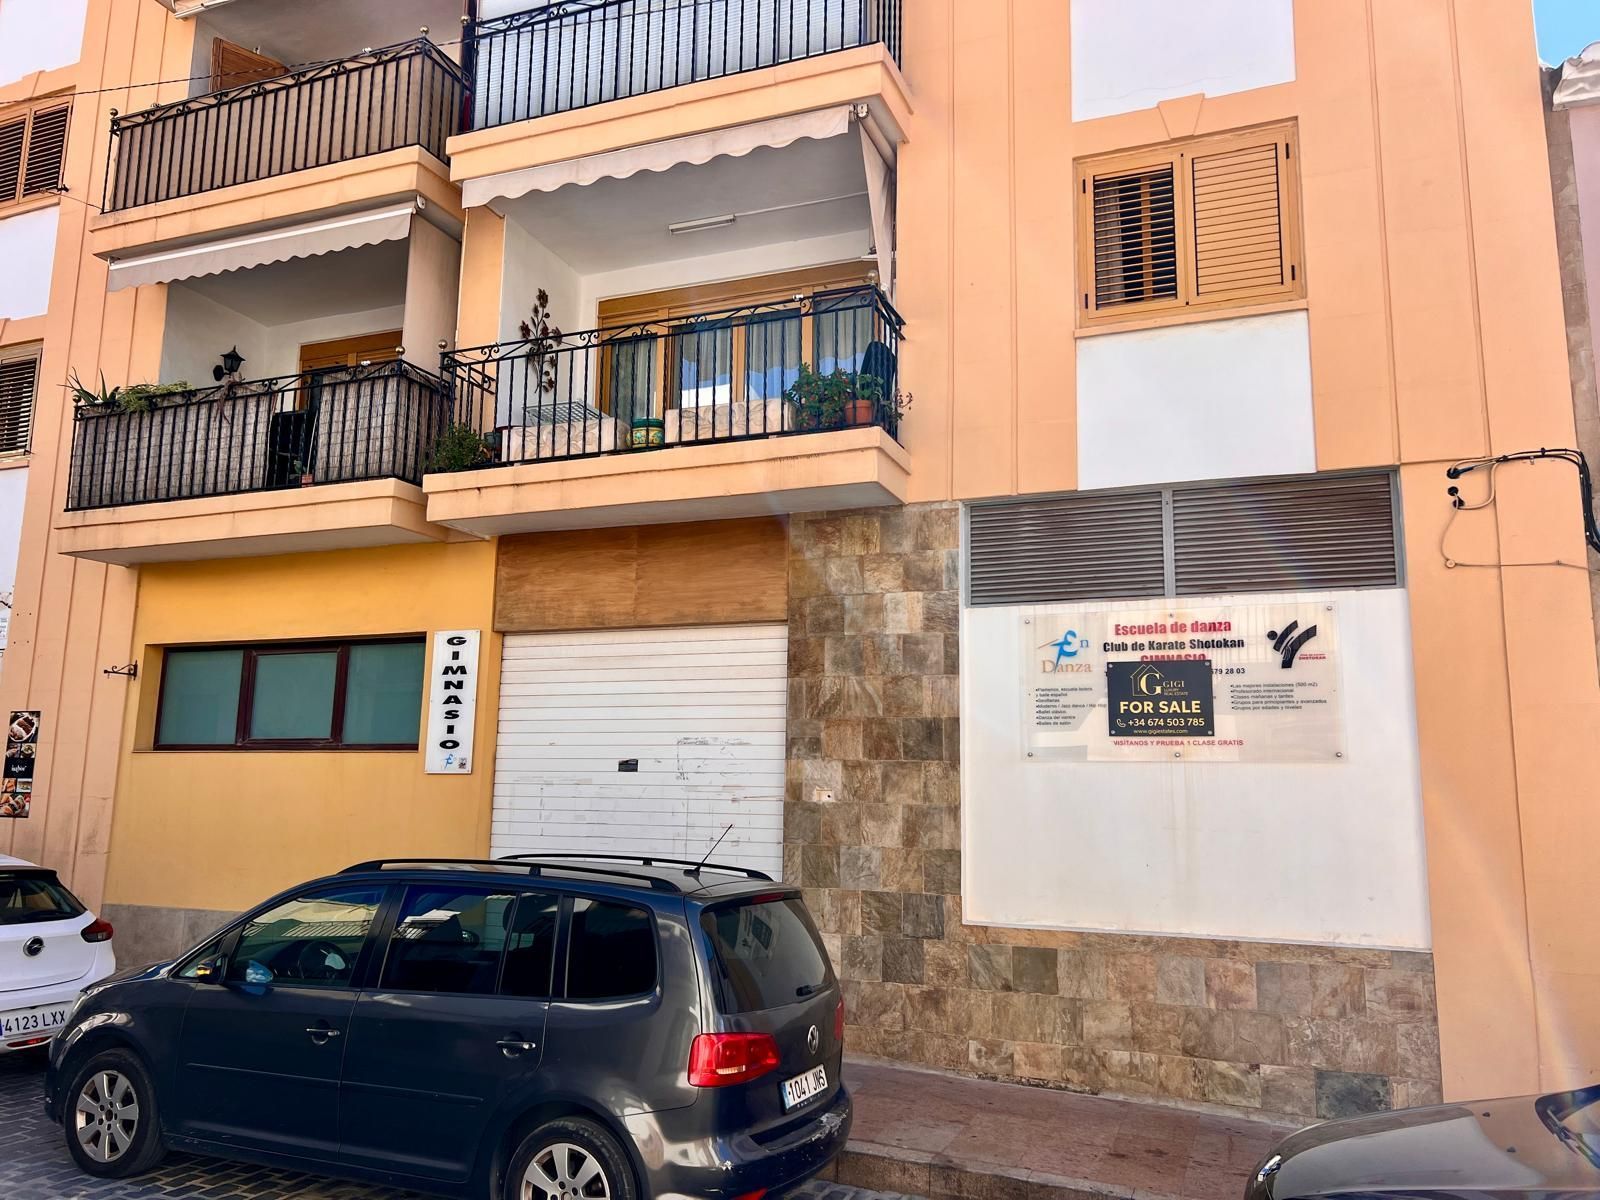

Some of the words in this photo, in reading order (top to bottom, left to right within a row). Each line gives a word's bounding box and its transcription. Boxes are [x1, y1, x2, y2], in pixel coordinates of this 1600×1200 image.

[1114, 622, 1167, 636] Escuela
[1170, 621, 1187, 633] de
[1190, 620, 1231, 633] danza
[1103, 641, 1128, 652] Club
[1131, 641, 1145, 651] de
[1148, 640, 1186, 651] Karate
[1189, 638, 1245, 649] Shotokan
[1041, 660, 1093, 673] Danza
[1162, 680, 1185, 688] GIGI
[439, 636, 467, 750] GIMNASIO
[1120, 701, 1154, 713] FOR
[1159, 700, 1201, 713] SALE
[1128, 718, 1145, 726] +34
[1147, 718, 1164, 726] 674
[1167, 718, 1184, 726] 503
[1187, 718, 1205, 726] 785
[5, 1014, 39, 1032] 4123
[42, 1010, 66, 1027] LXX
[789, 1074, 811, 1102] 1041
